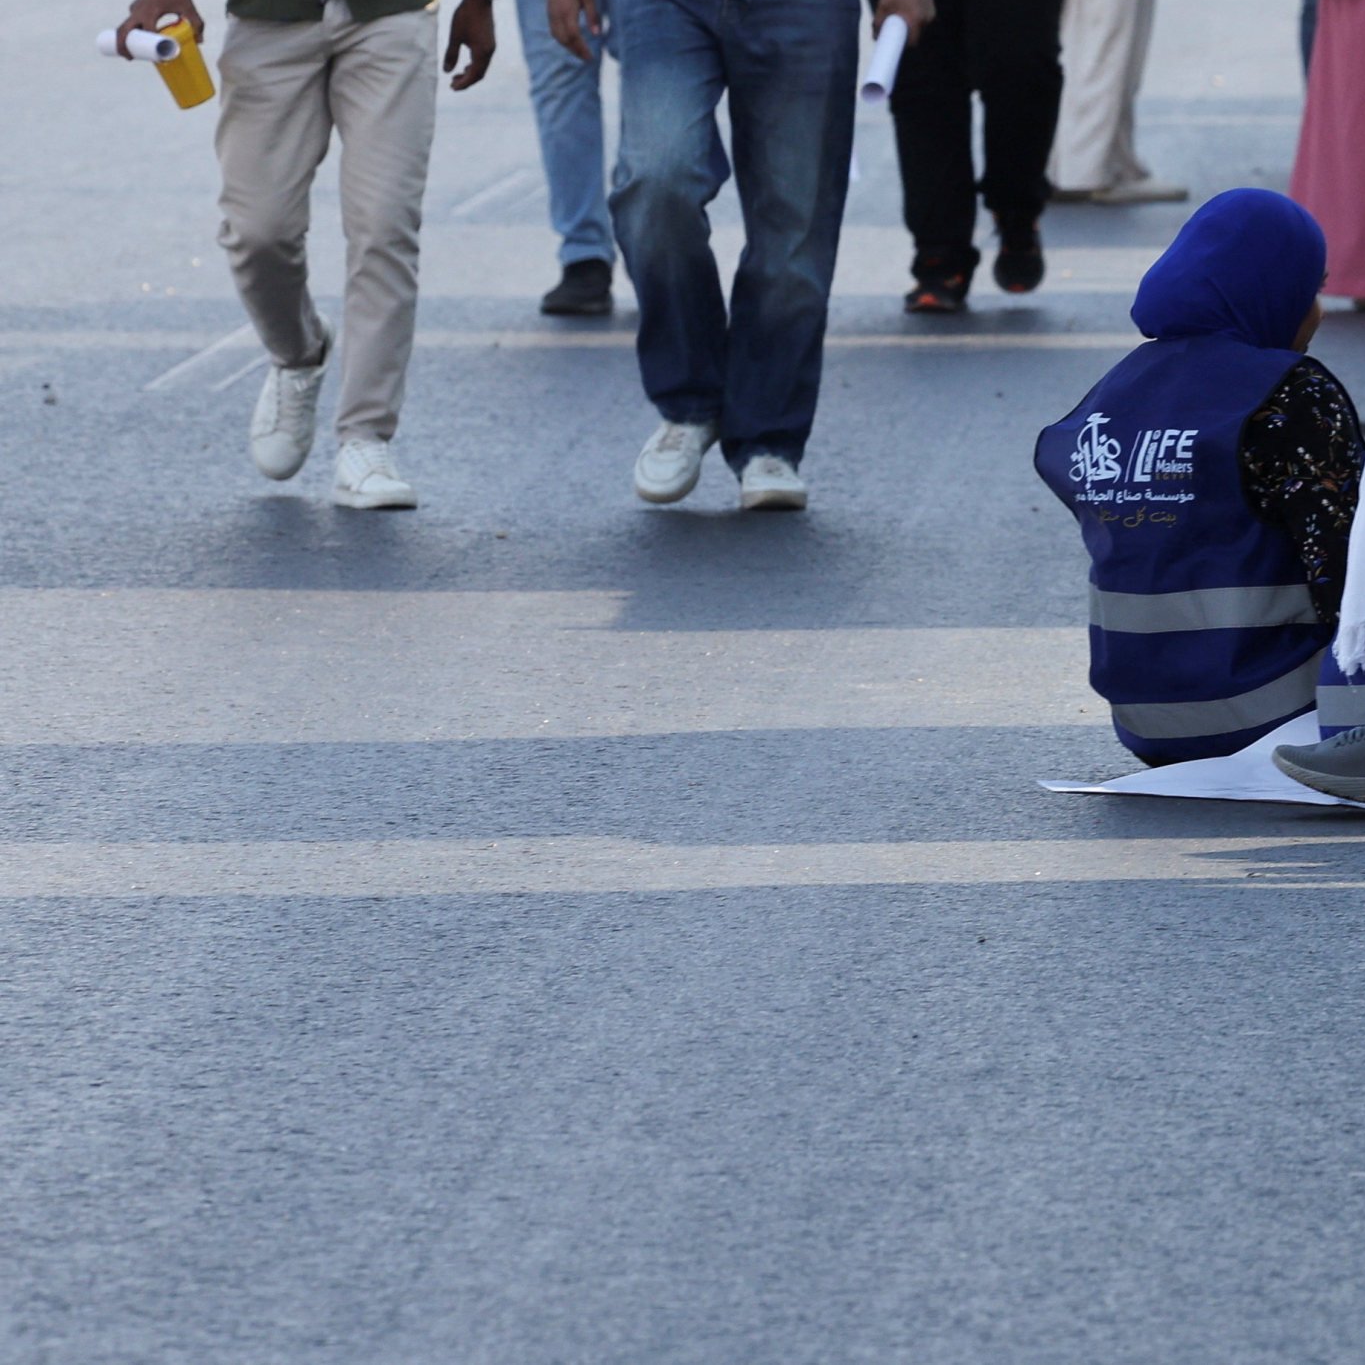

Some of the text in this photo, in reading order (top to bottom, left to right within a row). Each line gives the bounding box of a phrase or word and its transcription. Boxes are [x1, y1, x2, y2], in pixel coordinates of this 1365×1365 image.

[1155, 459, 1194, 474] Makers
[1115, 488, 1143, 504] صناع
[1144, 488, 1197, 504] مؤسسة
